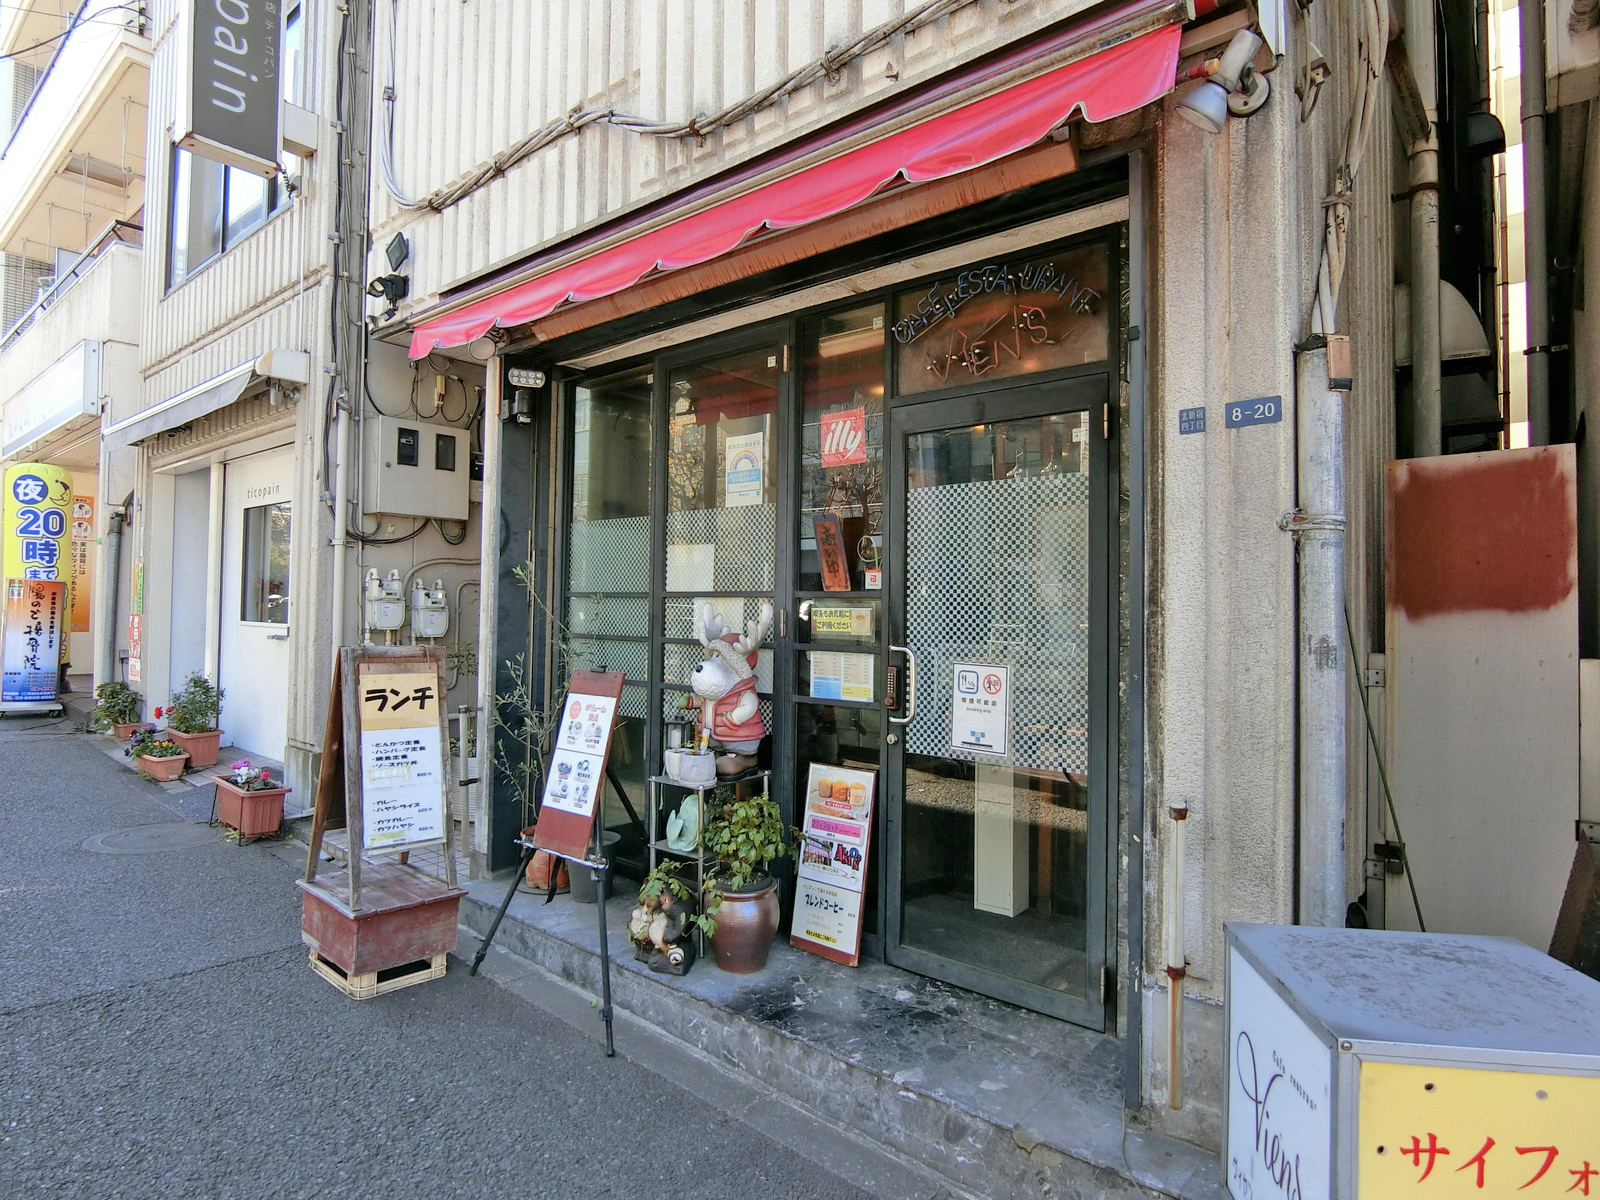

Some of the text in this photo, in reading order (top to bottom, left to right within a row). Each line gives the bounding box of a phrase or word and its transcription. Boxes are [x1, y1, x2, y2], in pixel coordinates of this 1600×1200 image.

[1231, 402, 1276, 422] 8-20
[1181, 420, 1204, 431] 四丁目
[824, 419, 863, 461] illy
[16, 478, 45, 502] 夜
[247, 482, 280, 499] ticopain
[18, 508, 65, 537] 20
[25, 540, 58, 565] 時
[364, 686, 434, 712] ランチ
[1399, 1132, 1600, 1197] サイフォ
